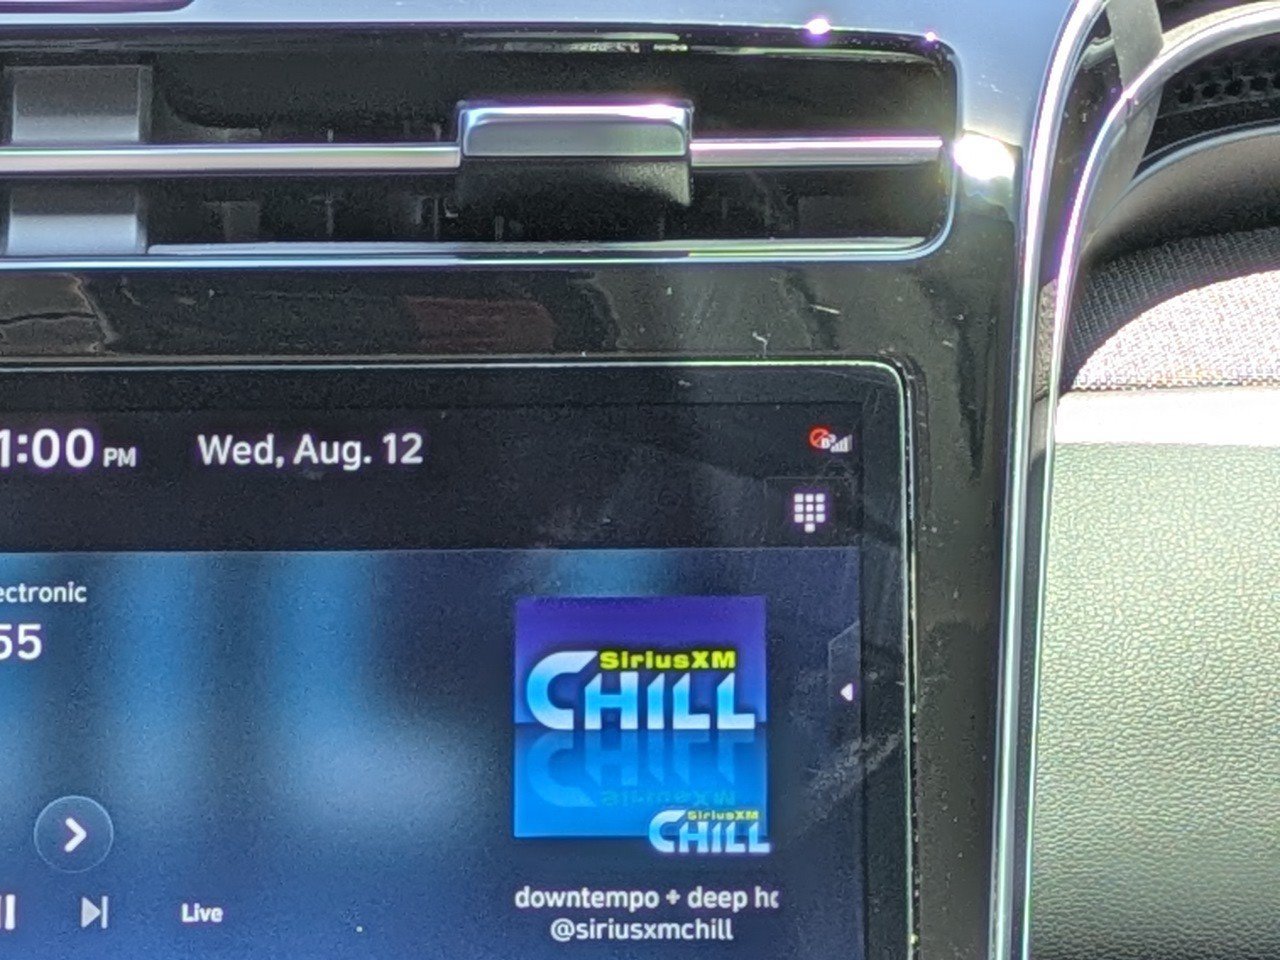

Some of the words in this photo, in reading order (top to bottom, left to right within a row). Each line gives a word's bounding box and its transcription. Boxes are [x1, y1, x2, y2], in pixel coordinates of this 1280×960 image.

[104, 448, 136, 467] PM
[198, 435, 285, 468] Wed,
[294, 436, 372, 471] Aug.
[382, 434, 423, 465] 12
[600, 651, 736, 669] SiriusXM
[527, 650, 756, 730] CHILL
[687, 810, 759, 821] SiriusXM
[649, 809, 771, 854] CHILL
[514, 886, 659, 914] downtempo
[687, 886, 748, 914] deep
[181, 904, 224, 923] Live
[550, 918, 733, 942] @siriusxmchill
